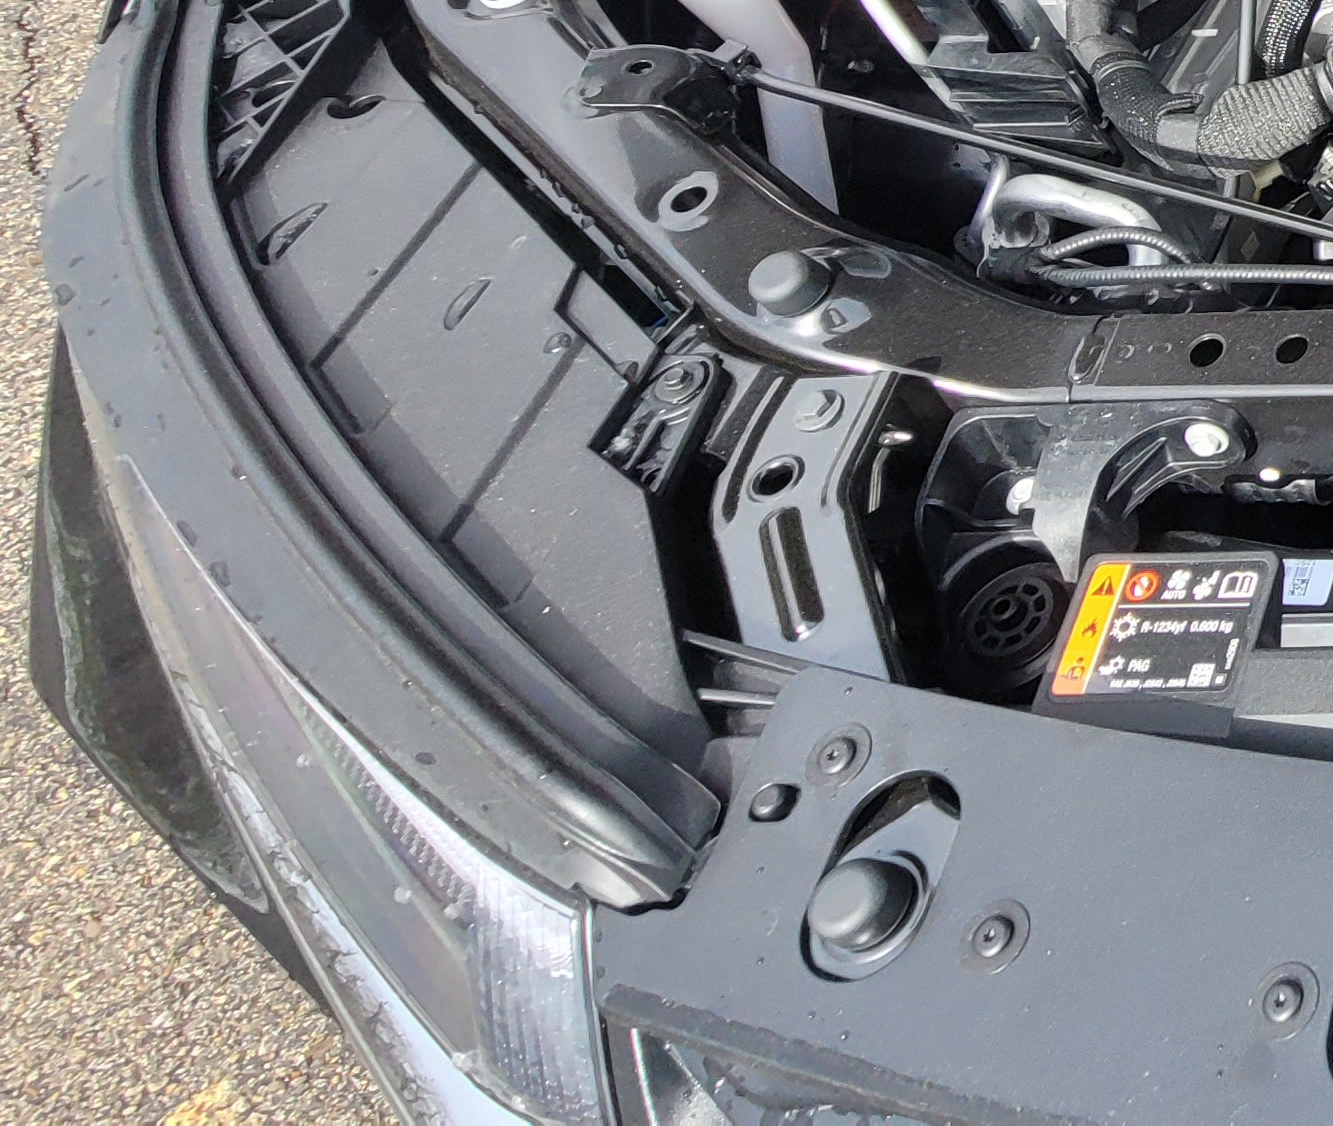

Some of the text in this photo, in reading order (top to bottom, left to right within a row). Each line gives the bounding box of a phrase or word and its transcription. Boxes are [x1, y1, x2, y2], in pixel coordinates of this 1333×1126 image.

[1161, 589, 1187, 600] AUTO
[1140, 620, 1233, 634] R-1234yf 0.600 kg
[1127, 659, 1150, 672] PAG
